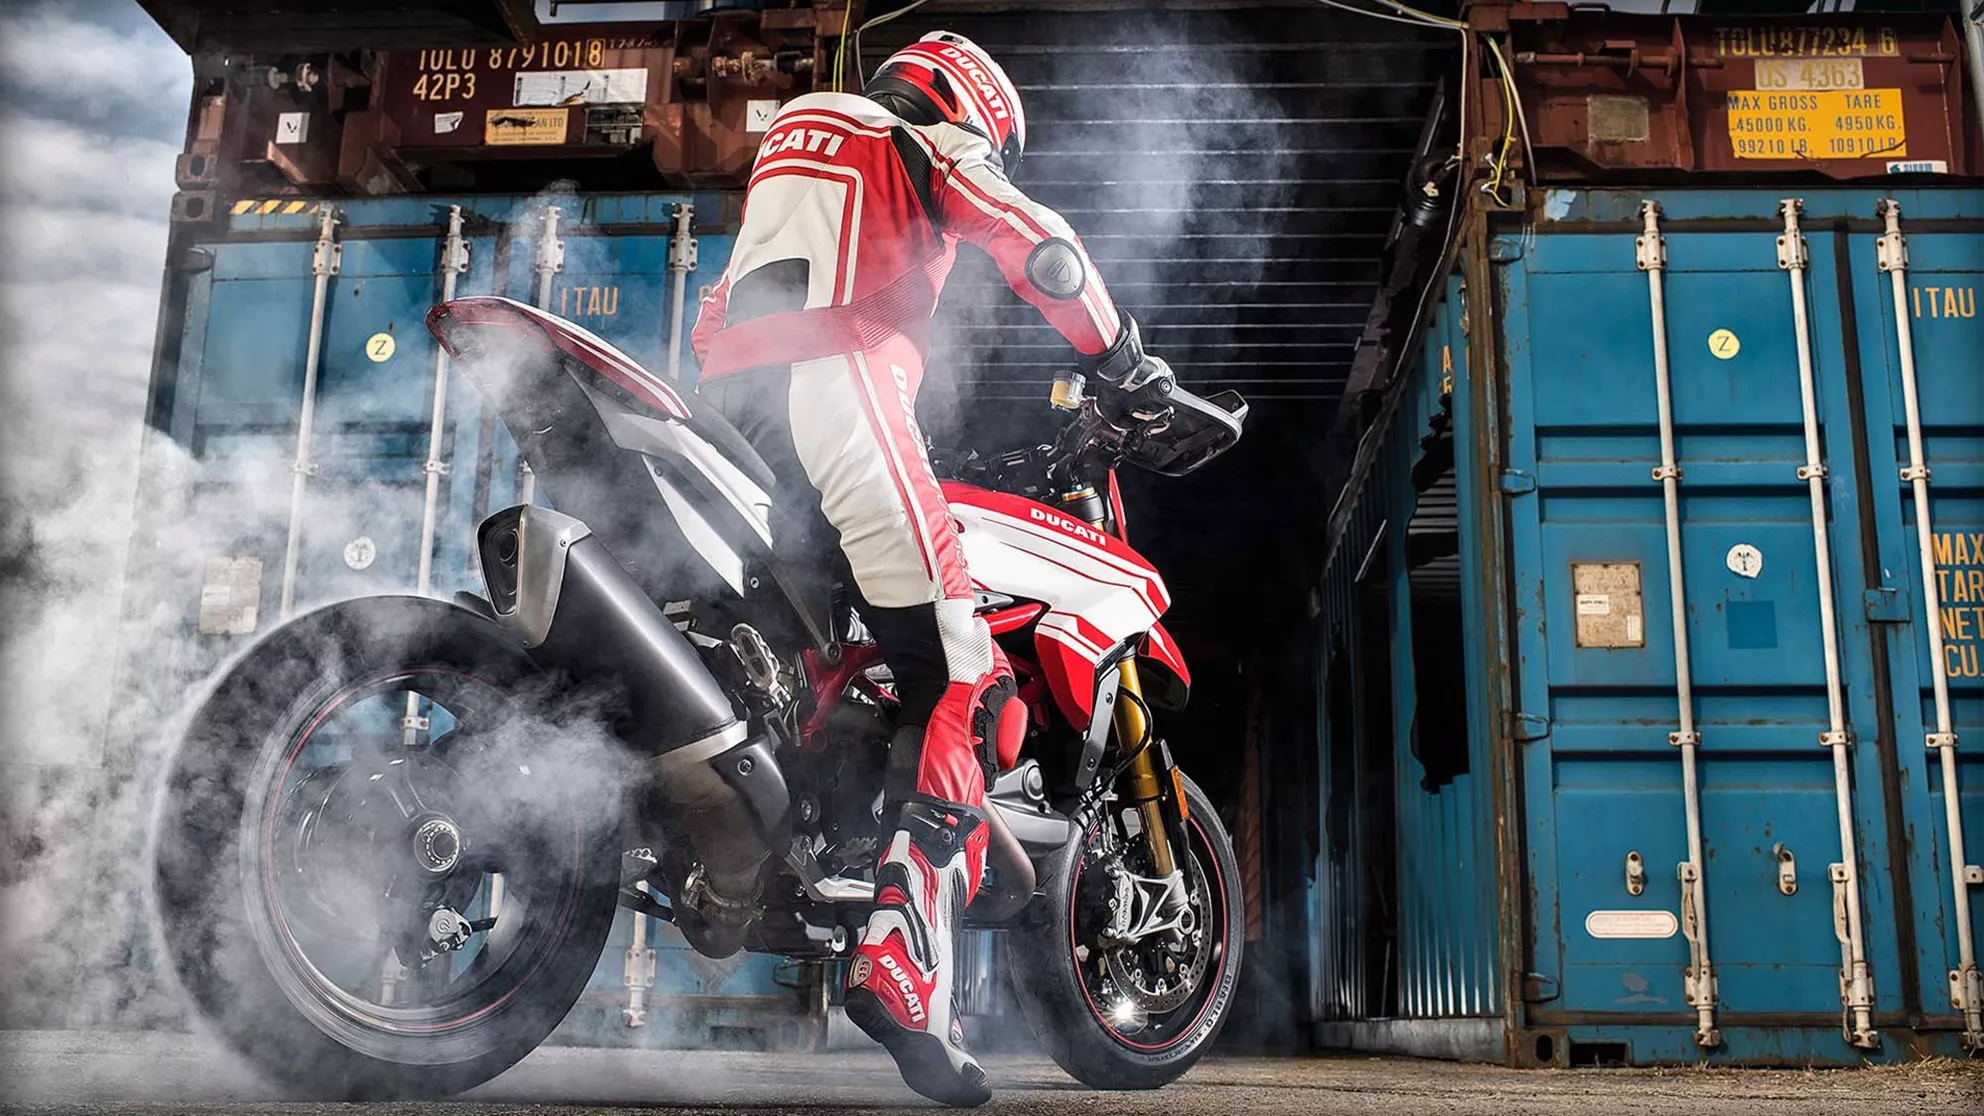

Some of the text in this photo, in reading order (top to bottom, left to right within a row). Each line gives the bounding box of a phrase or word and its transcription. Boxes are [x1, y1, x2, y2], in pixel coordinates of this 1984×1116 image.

[413, 74, 476, 100] 42P3
[939, 47, 1009, 120] DUCATI
[1758, 59, 1861, 88] US 4363
[1727, 94, 1881, 110] MAX GROSS TARE
[1736, 117, 1783, 132] 45000
[1835, 115, 1873, 131] 4950
[1738, 139, 1785, 154] 99210
[1829, 137, 1875, 153] 10910
[560, 286, 619, 317] ITAU
[1912, 287, 1976, 319] ITAU
[375, 340, 387, 356] Z
[1717, 335, 1731, 352] Z
[1030, 507, 1106, 546] DUCATI
[1931, 533, 1984, 566] MAX
[1939, 607, 1984, 640] NET
[877, 954, 926, 1023] DUCATI
